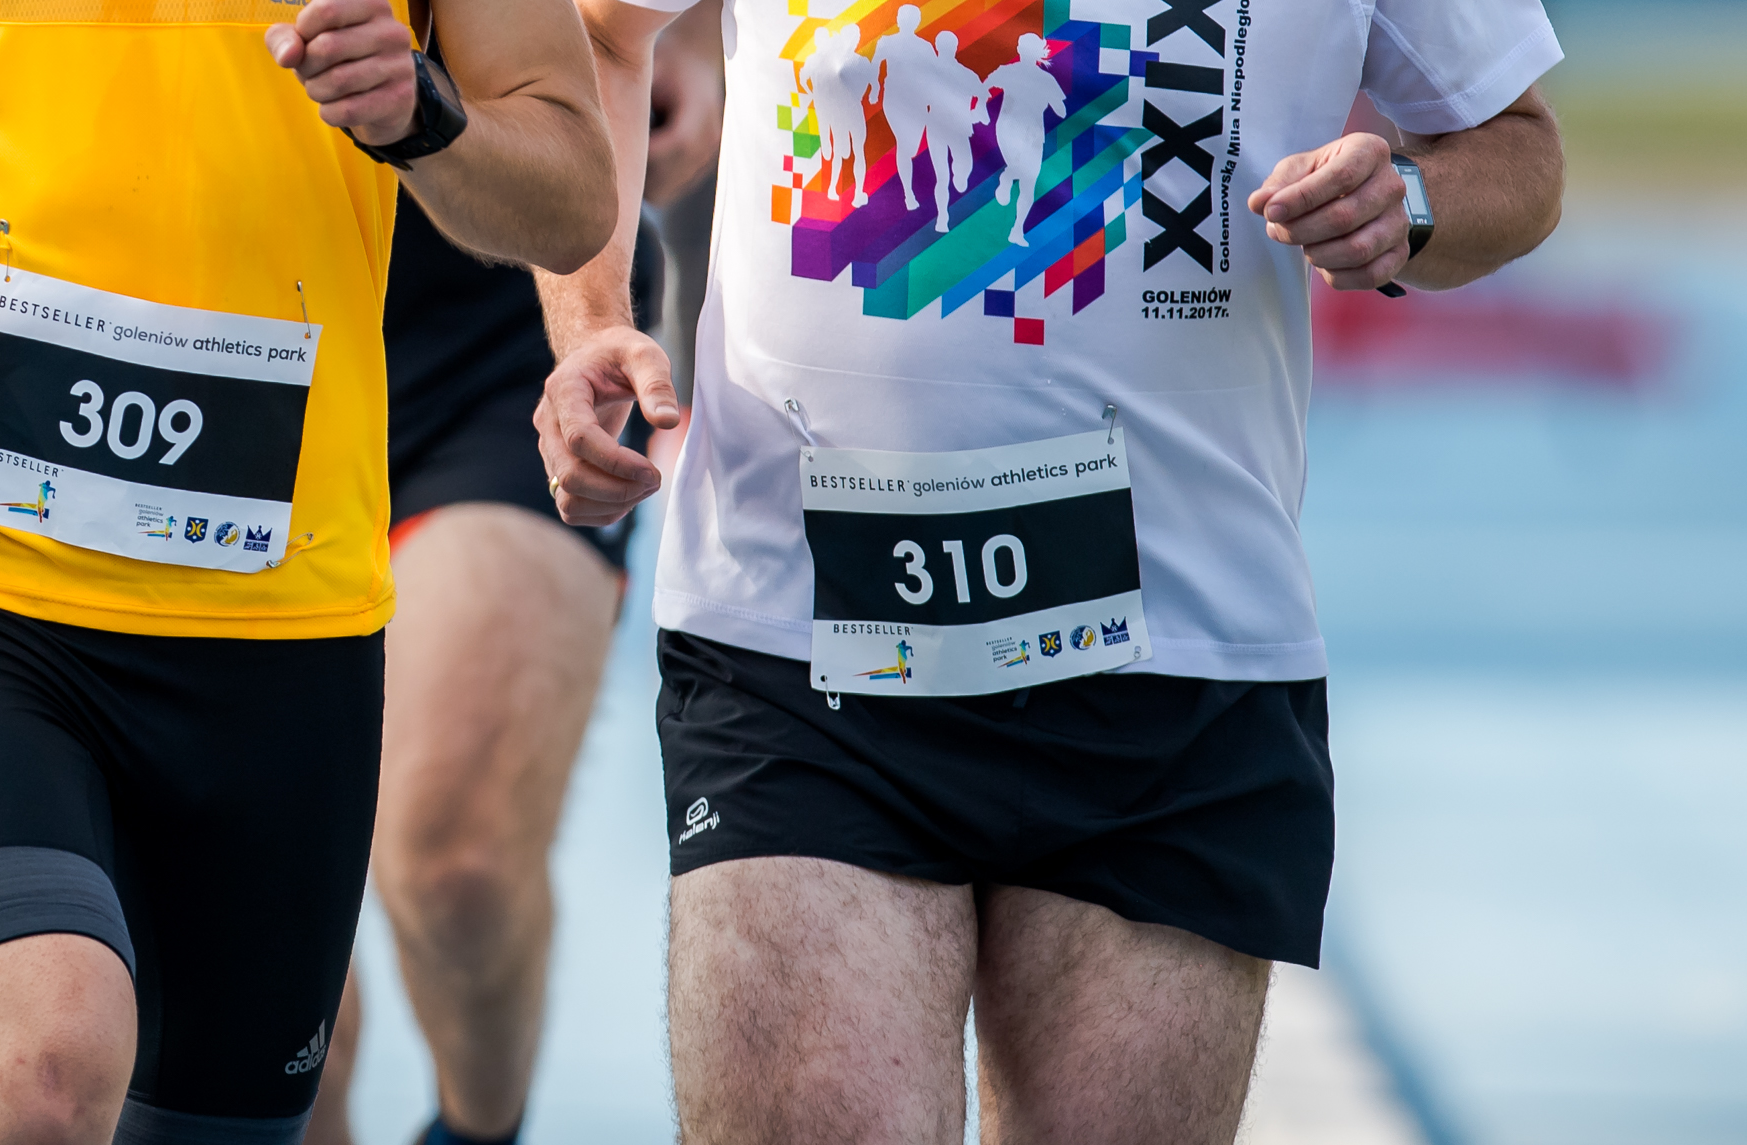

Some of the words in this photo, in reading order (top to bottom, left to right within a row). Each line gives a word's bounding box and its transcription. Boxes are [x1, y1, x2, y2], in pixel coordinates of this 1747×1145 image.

[1226, 118, 1241, 158] Mila
[1219, 159, 1237, 273] Goleniowska
[1141, 306, 1229, 320] 11.11.2017r.
[1142, 287, 1231, 304] GOLENIÓW
[112, 323, 189, 349] goleniów
[193, 335, 262, 357] athletics
[267, 343, 307, 363] park
[59, 379, 203, 466] 309
[810, 475, 906, 493] BESTSELLER
[912, 475, 986, 497] goleniów
[990, 463, 1068, 487] athletics
[1074, 454, 1118, 477] park
[892, 533, 1028, 605] 310
[833, 624, 911, 636] BESTSELLER
[284, 1044, 327, 1075] adidas
